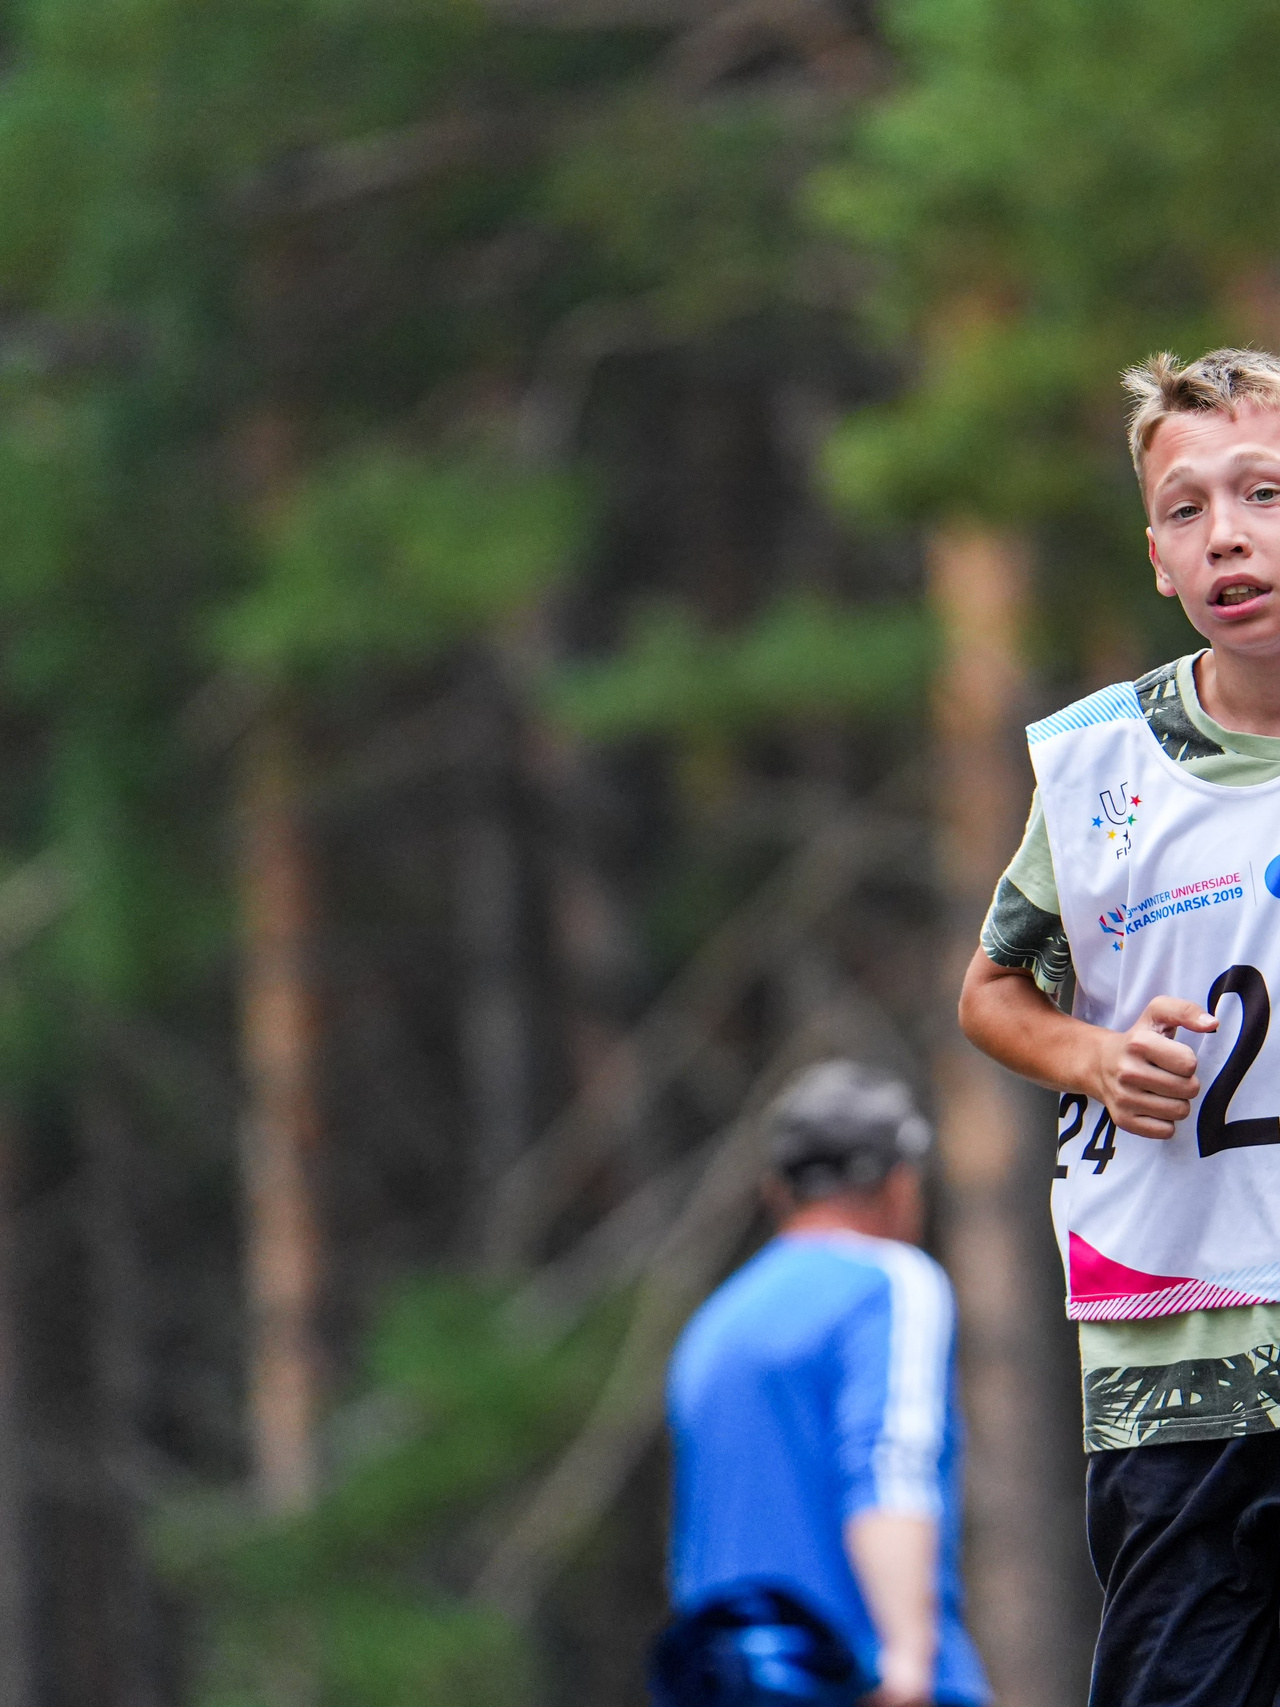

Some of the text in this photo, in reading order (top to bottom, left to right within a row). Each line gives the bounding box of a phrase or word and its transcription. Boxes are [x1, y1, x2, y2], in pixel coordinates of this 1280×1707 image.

[1125, 886, 1243, 935] KRASNOYARSK 2019
[1138, 891, 1171, 912] WINTER
[1171, 872, 1241, 899] UNIVERSIADE
[1055, 1093, 1116, 1179] 24
